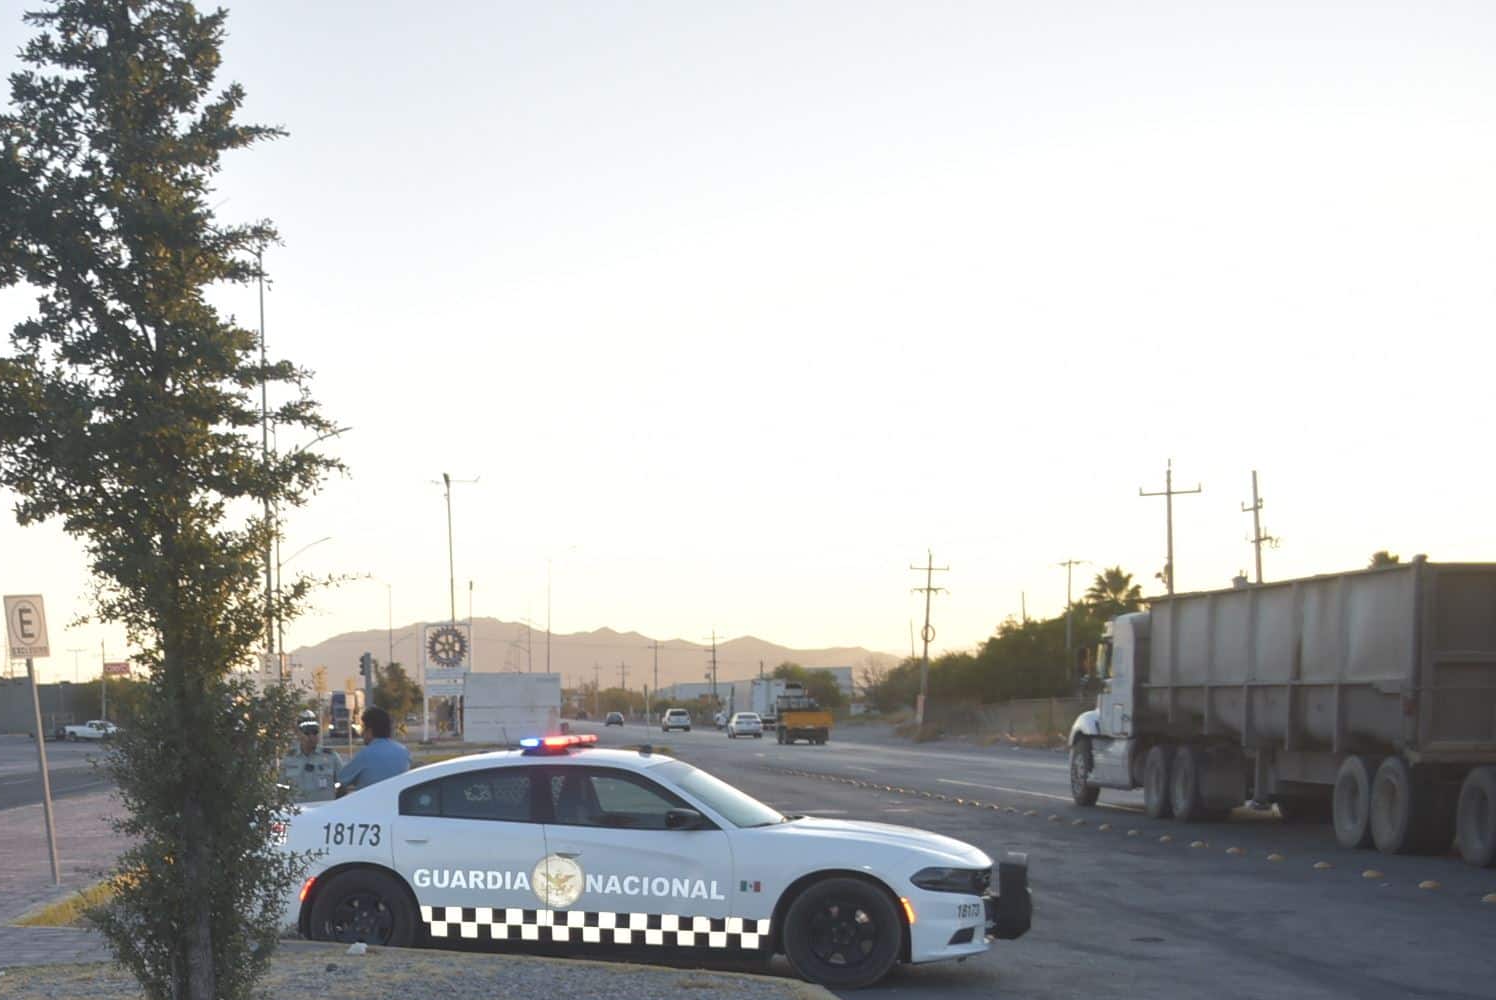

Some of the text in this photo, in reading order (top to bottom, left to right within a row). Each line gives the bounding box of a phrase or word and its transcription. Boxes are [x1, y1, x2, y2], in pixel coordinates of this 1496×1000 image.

[18, 607, 35, 639] E
[323, 822, 381, 847] 18173
[413, 868, 725, 900] GUARDIA NACIONAL
